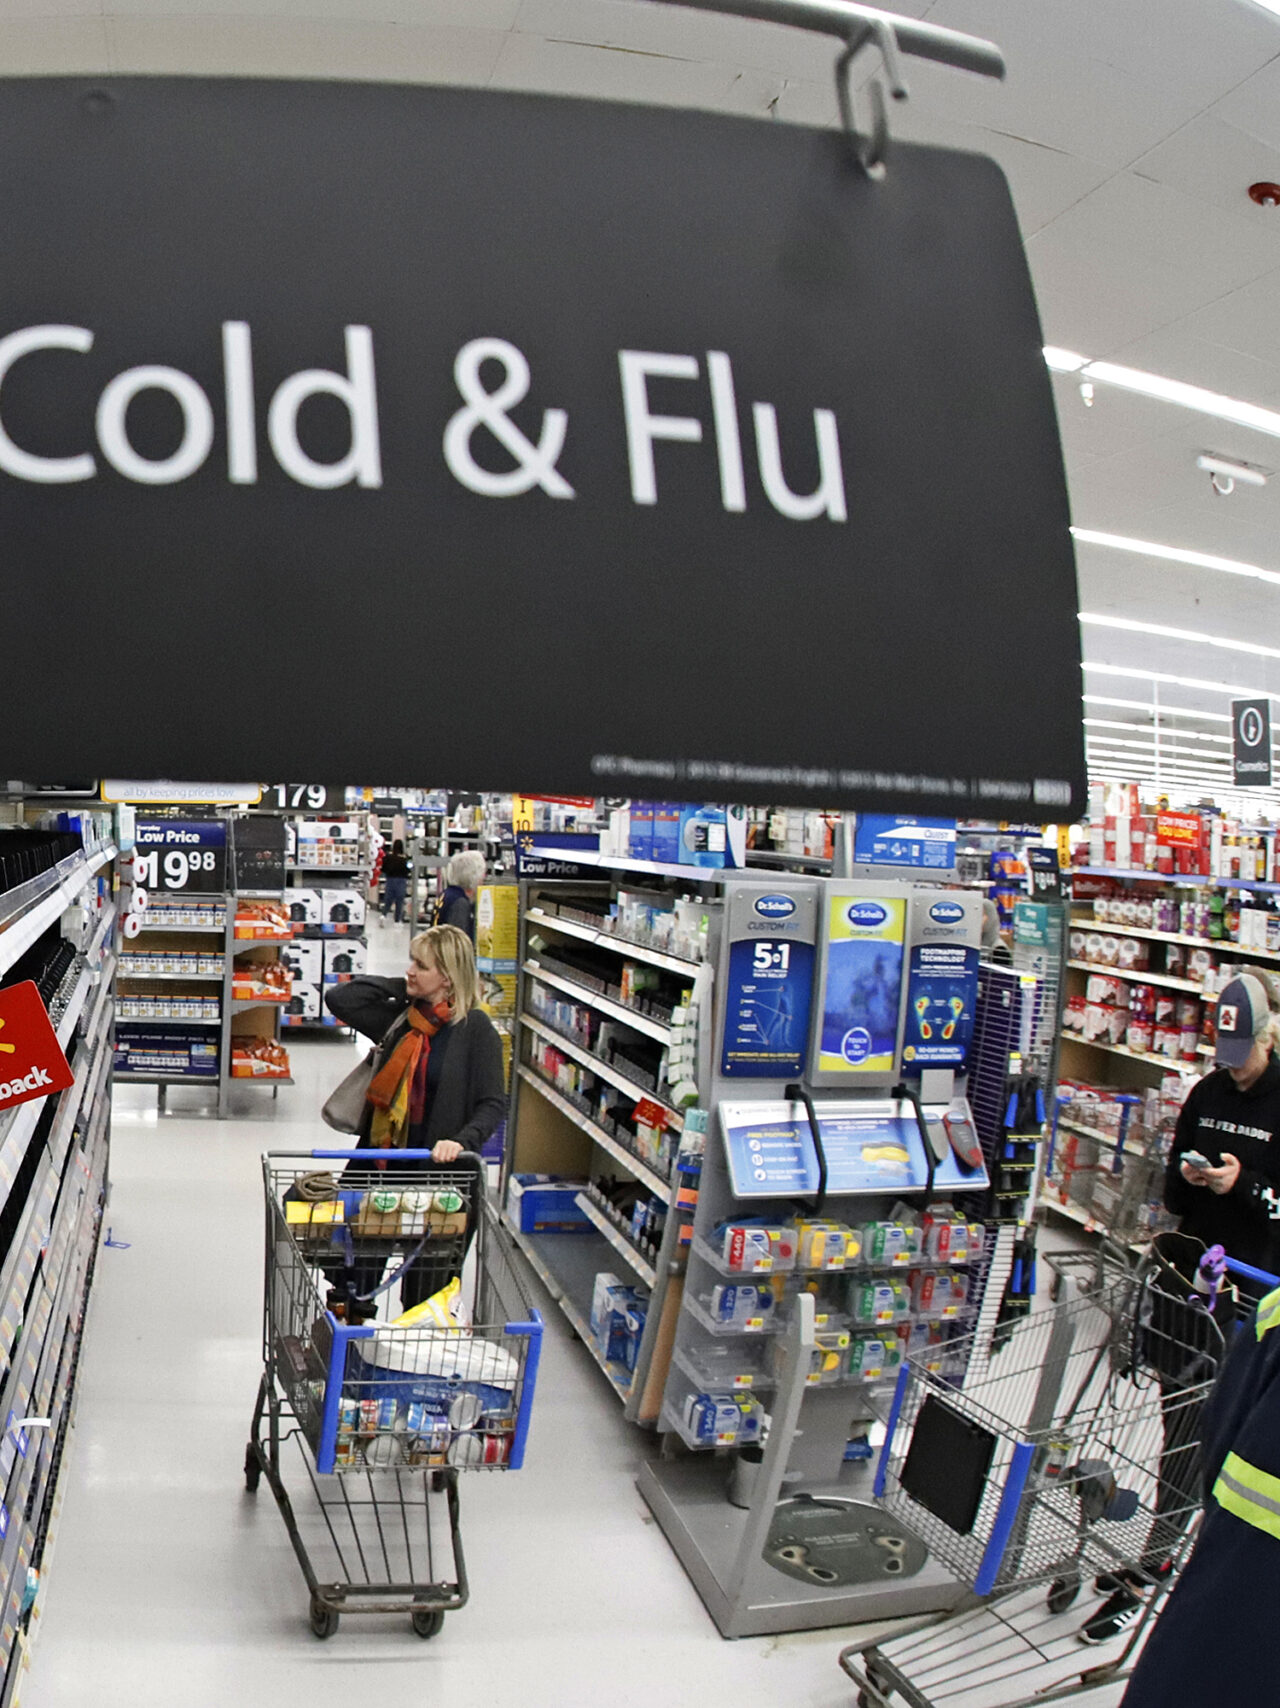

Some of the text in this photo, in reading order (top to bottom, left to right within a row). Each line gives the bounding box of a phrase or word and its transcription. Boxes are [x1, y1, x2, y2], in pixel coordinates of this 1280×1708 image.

[443, 337, 575, 498] &
[618, 350, 848, 522] Flu
[150, 787, 187, 799] keeping
[189, 787, 218, 799] prices
[136, 831, 200, 843] Low Price
[520, 862, 578, 874] Low Price
[747, 921, 784, 931] CUSTOM
[1237, 1123, 1273, 1143] DADDY
